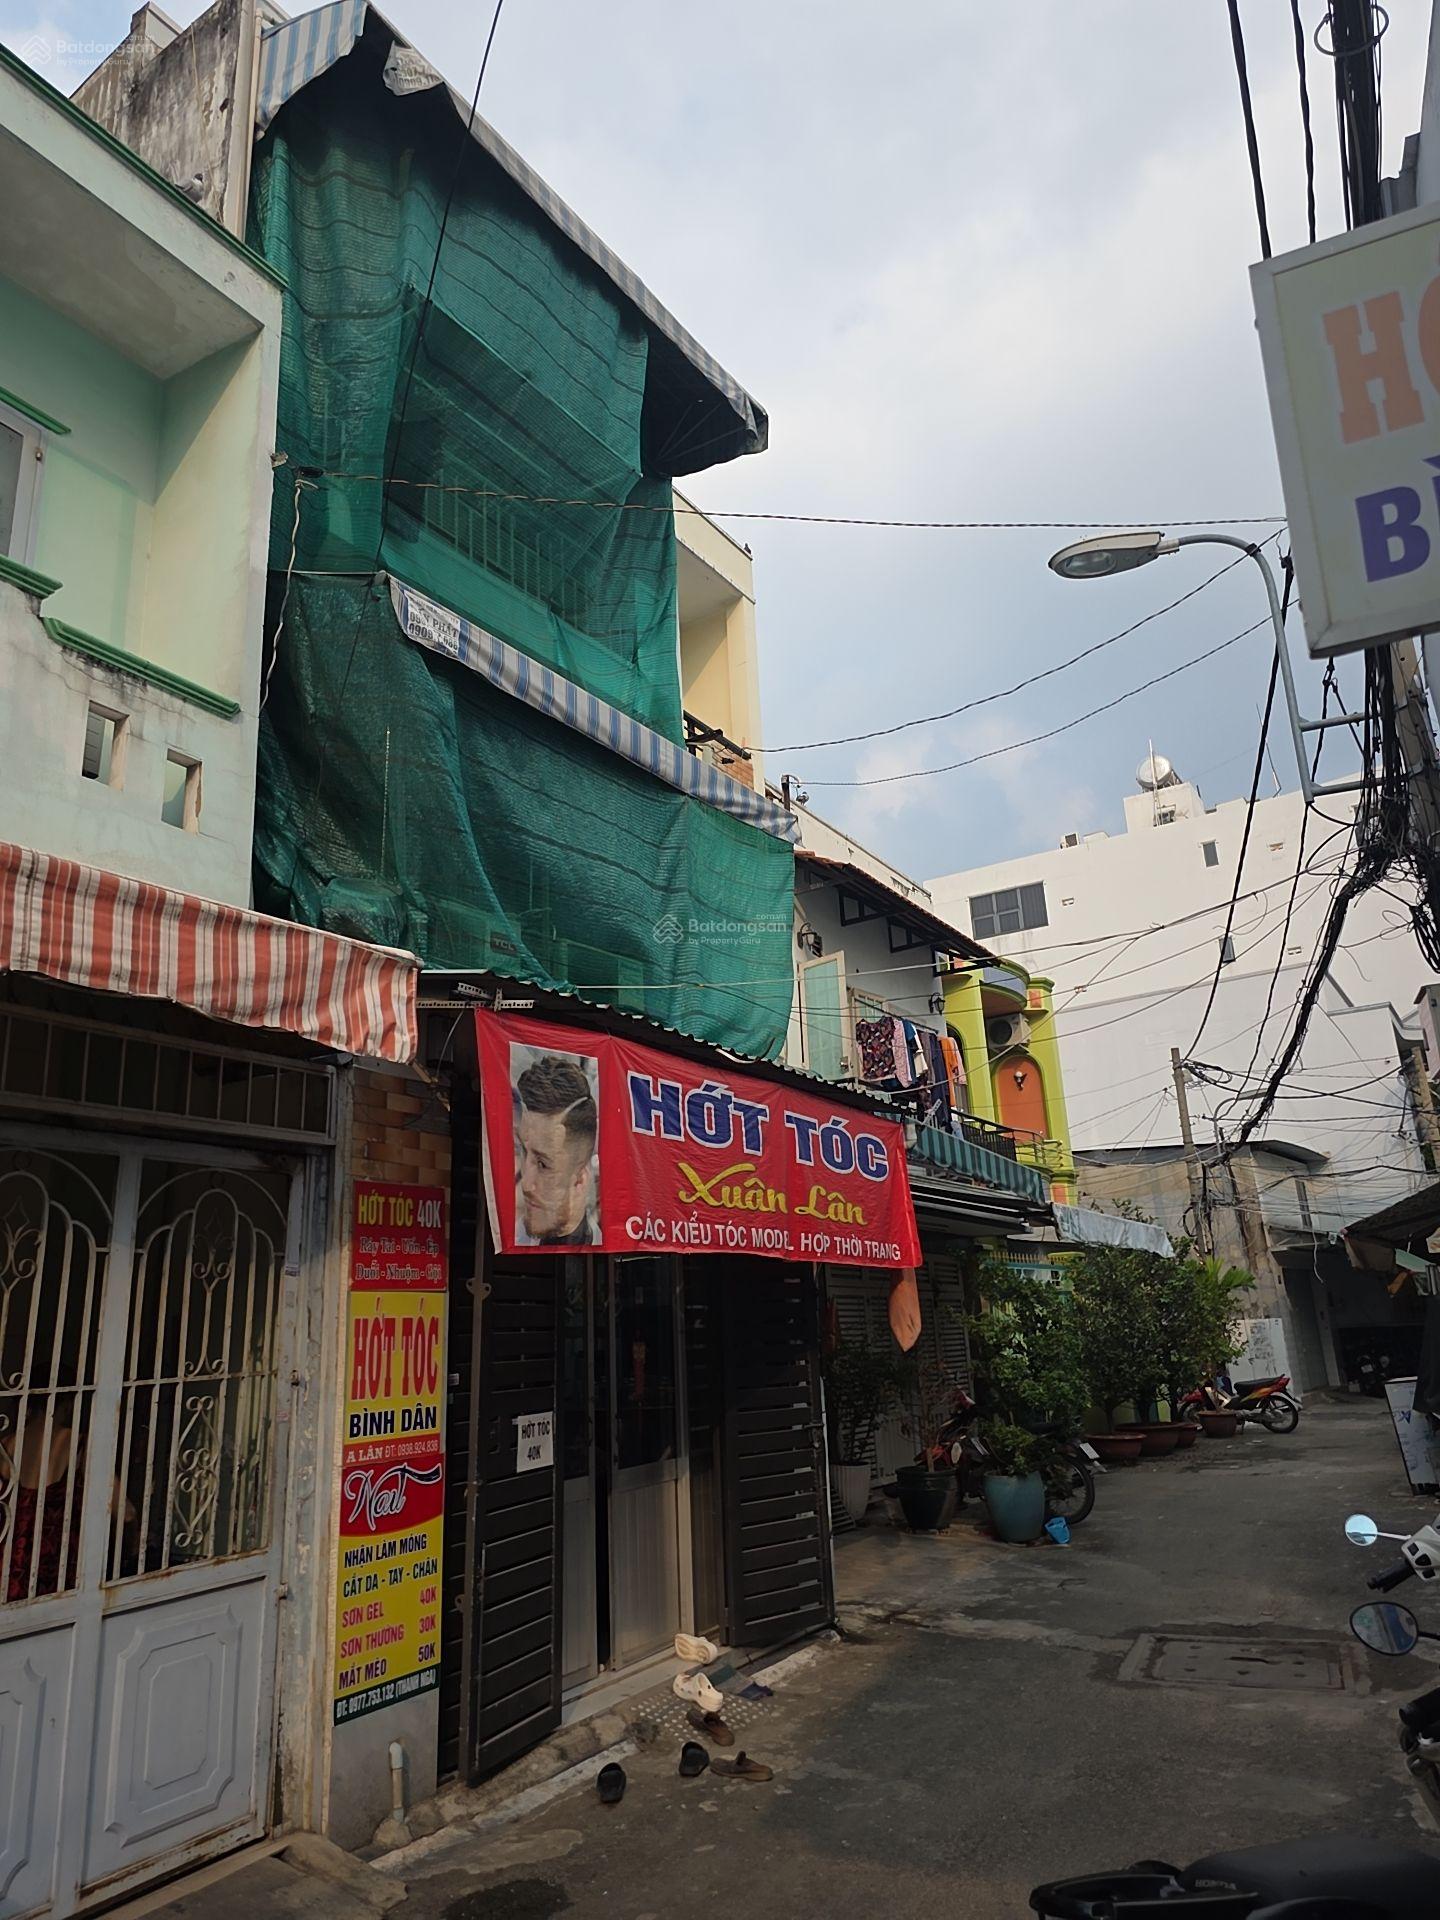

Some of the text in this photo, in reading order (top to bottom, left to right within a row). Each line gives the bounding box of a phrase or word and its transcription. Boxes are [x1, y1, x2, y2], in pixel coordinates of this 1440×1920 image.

[1322, 250, 1440, 445] H
[492, 937, 515, 951] TCL
[627, 1070, 890, 1182] HỚT TÓC
[358, 1189, 442, 1228] HỚT TÓC 40K
[678, 1162, 868, 1226] Xuân Lân
[625, 1211, 666, 1242] CÁC
[671, 1210, 712, 1245] KIỂU
[715, 1220, 747, 1247] TÓC
[800, 1231, 831, 1257] HỢP
[833, 1233, 862, 1257] THỜI
[864, 1240, 901, 1261] TRANG
[385, 1263, 420, 1285] Nhuộm
[351, 1297, 439, 1400] HỚT TÓC
[349, 1402, 437, 1438] BÌNH DÂN
[537, 1417, 551, 1437] TÓC
[346, 1451, 356, 1463] A
[358, 1445, 384, 1462] LÂN
[527, 1444, 542, 1461] 40K
[344, 1533, 427, 1568] NHẬN LÀM MÓNG
[343, 1572, 363, 1597] CẮT
[365, 1573, 379, 1592] DA
[388, 1567, 404, 1586] TAY
[412, 1556, 438, 1580] CHÂN
[342, 1585, 437, 1628] SƠN GEL 40K
[340, 1614, 436, 1659] SƠN THƯỜNG 30K
[339, 1642, 436, 1690] MẮT MÈO 50K
[1194, 1880, 1237, 1890] HONDA
